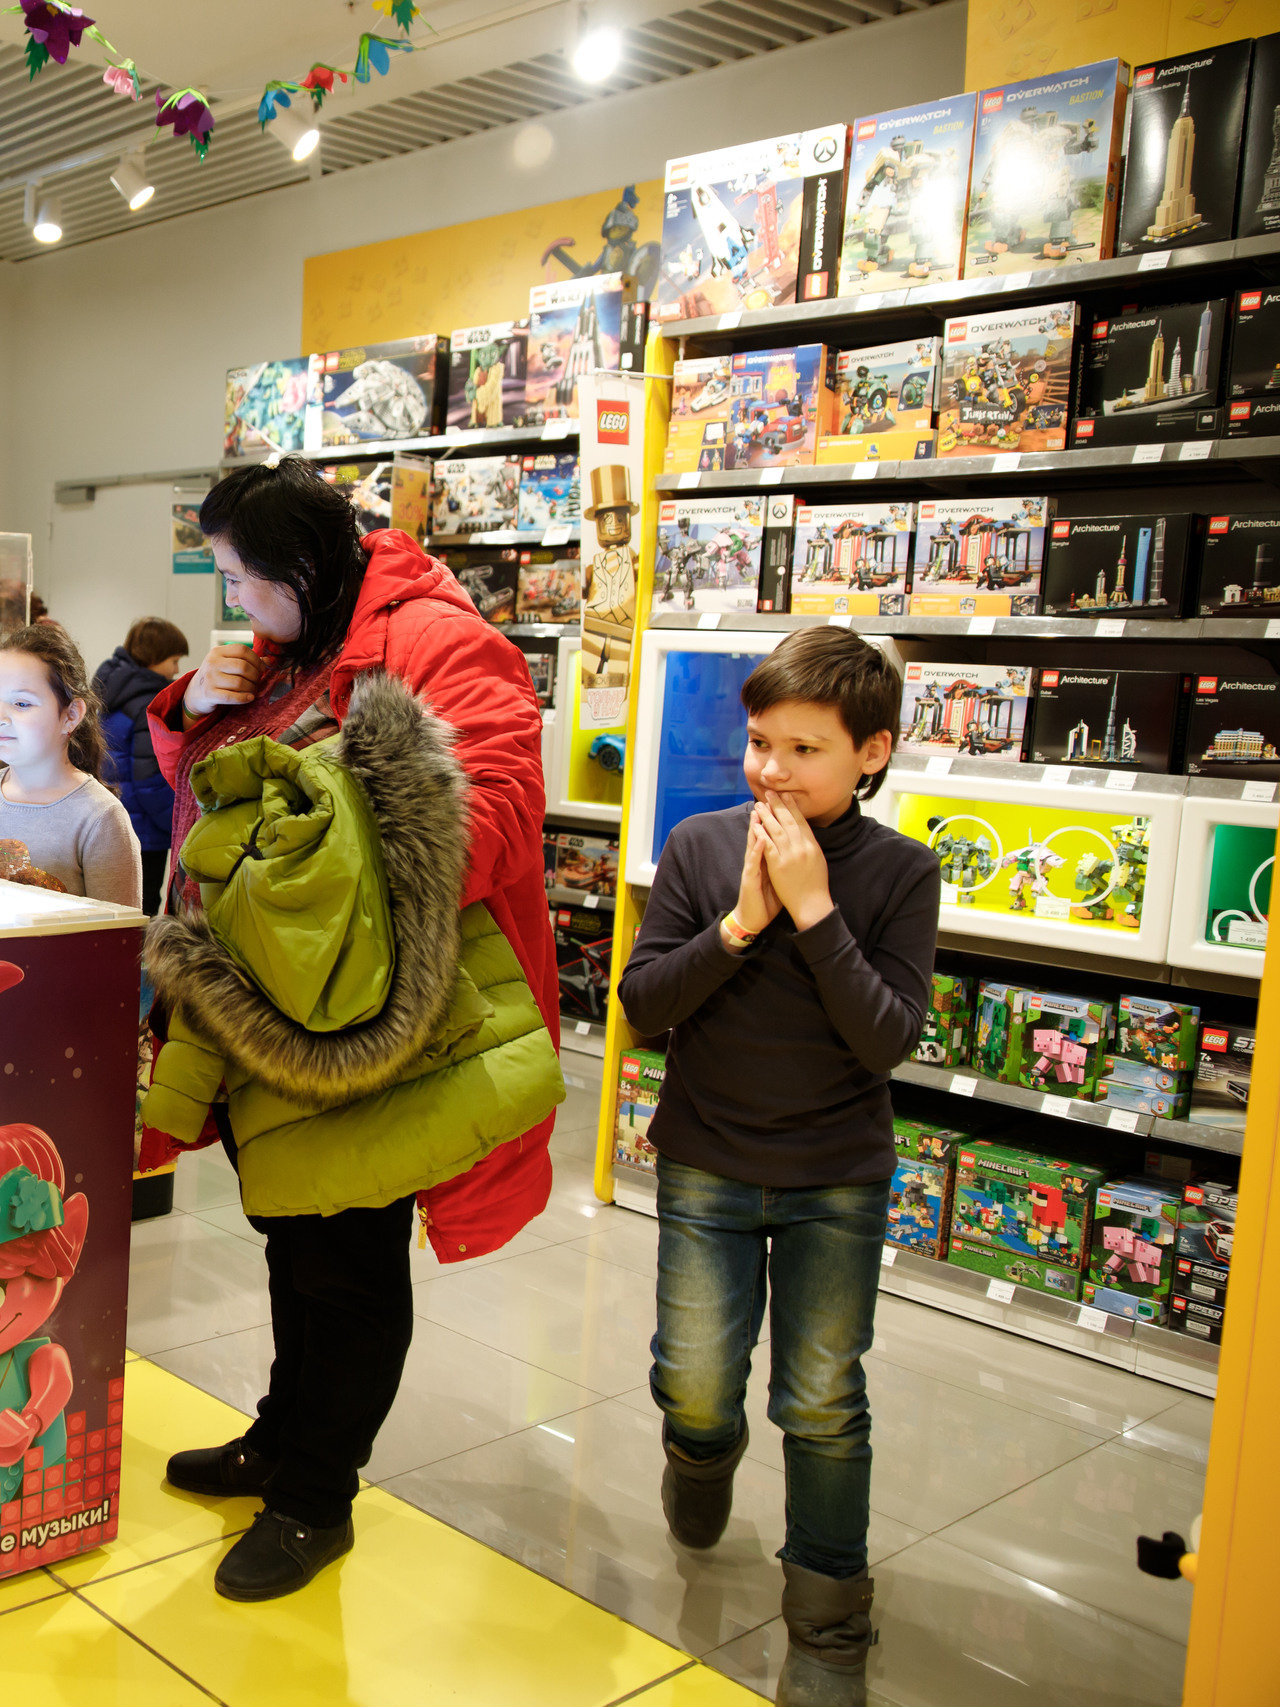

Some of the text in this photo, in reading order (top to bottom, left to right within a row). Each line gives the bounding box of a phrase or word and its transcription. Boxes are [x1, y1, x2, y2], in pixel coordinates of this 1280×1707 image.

[1137, 57, 1214, 82] LEGO Architecture
[982, 76, 1090, 109] LEGO OVERWATCH
[1068, 89, 1104, 106] BASTION
[878, 108, 952, 132] OVERWATCH
[932, 120, 965, 136] BASTION
[1241, 296, 1261, 306] LEGO
[949, 316, 1048, 339] LEGO OVERWATCH
[1093, 317, 1157, 335] LEGO Architecture
[850, 351, 894, 363] OVERWATCH
[1230, 406, 1250, 416] LEGO
[598, 411, 630, 433] LEGO
[1077, 424, 1094, 433] LEGO
[677, 506, 737, 516] OVERWATCH
[814, 511, 864, 519] OVERWATCH
[937, 505, 994, 514] OVERWATCH
[1053, 523, 1120, 535] LEGO Architecture
[1210, 521, 1228, 530] LEGO
[923, 670, 979, 679] OVERWATCH
[1042, 674, 1109, 685] LEGO Architecture
[1198, 680, 1276, 692] LEGO Architecture
[1043, 1001, 1081, 1013] MINECRAFT
[1131, 1002, 1163, 1014] MINECRAFT
[1203, 1034, 1227, 1046] LEGO
[1200, 1052, 1212, 1062] 7+
[622, 1063, 639, 1074] LEGO
[620, 1080, 632, 1090] 8+
[977, 1159, 1030, 1178] MINECRAFT
[1185, 1190, 1203, 1200] LEGO
[1113, 1198, 1152, 1212] MINECRAFT
[964, 1244, 998, 1259] MINECRAFT
[1193, 1265, 1228, 1282] SPEED
[1187, 1302, 1222, 1319] SPEED
[21, 1500, 110, 1548] музыки!
